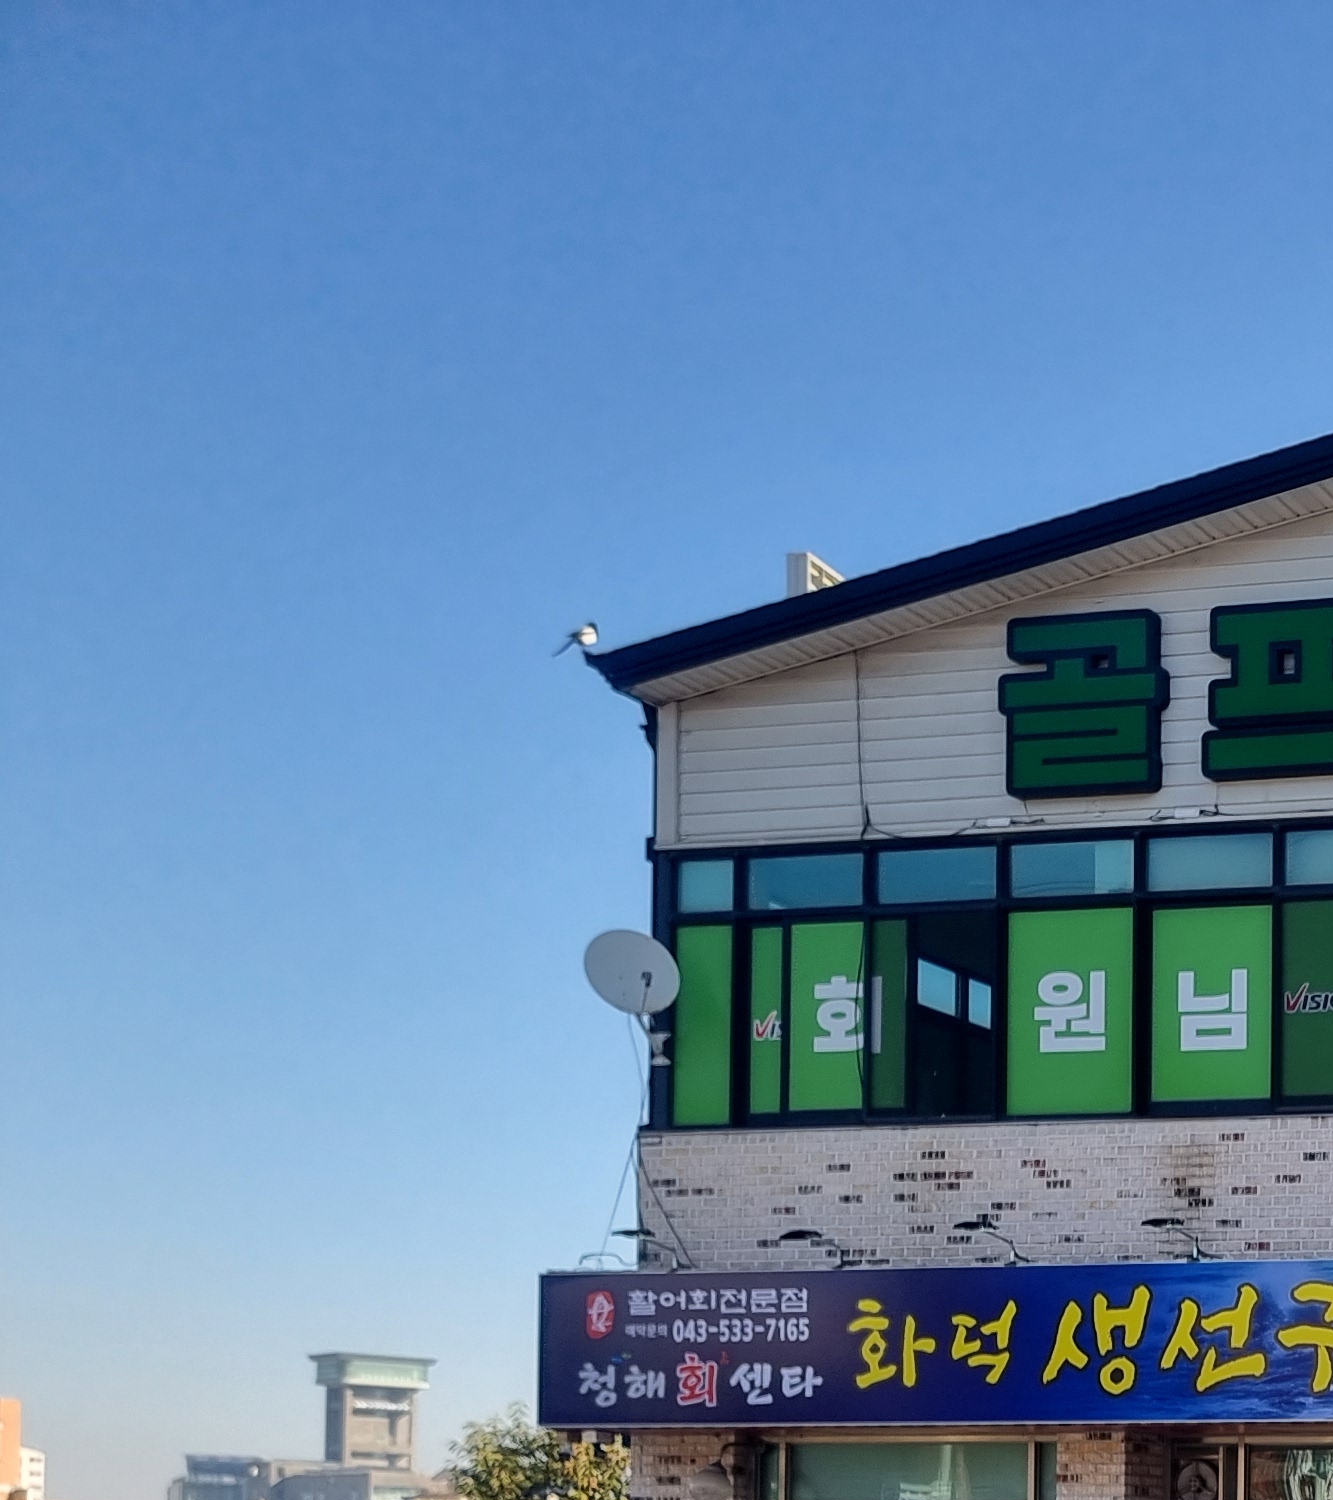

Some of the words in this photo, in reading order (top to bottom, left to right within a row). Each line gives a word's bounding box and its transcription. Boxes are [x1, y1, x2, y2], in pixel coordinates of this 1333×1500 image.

[628, 1287, 808, 1316] 활어회전문점
[672, 1317, 810, 1343] 043-533-7165
[848, 1299, 1016, 1388] 화덕
